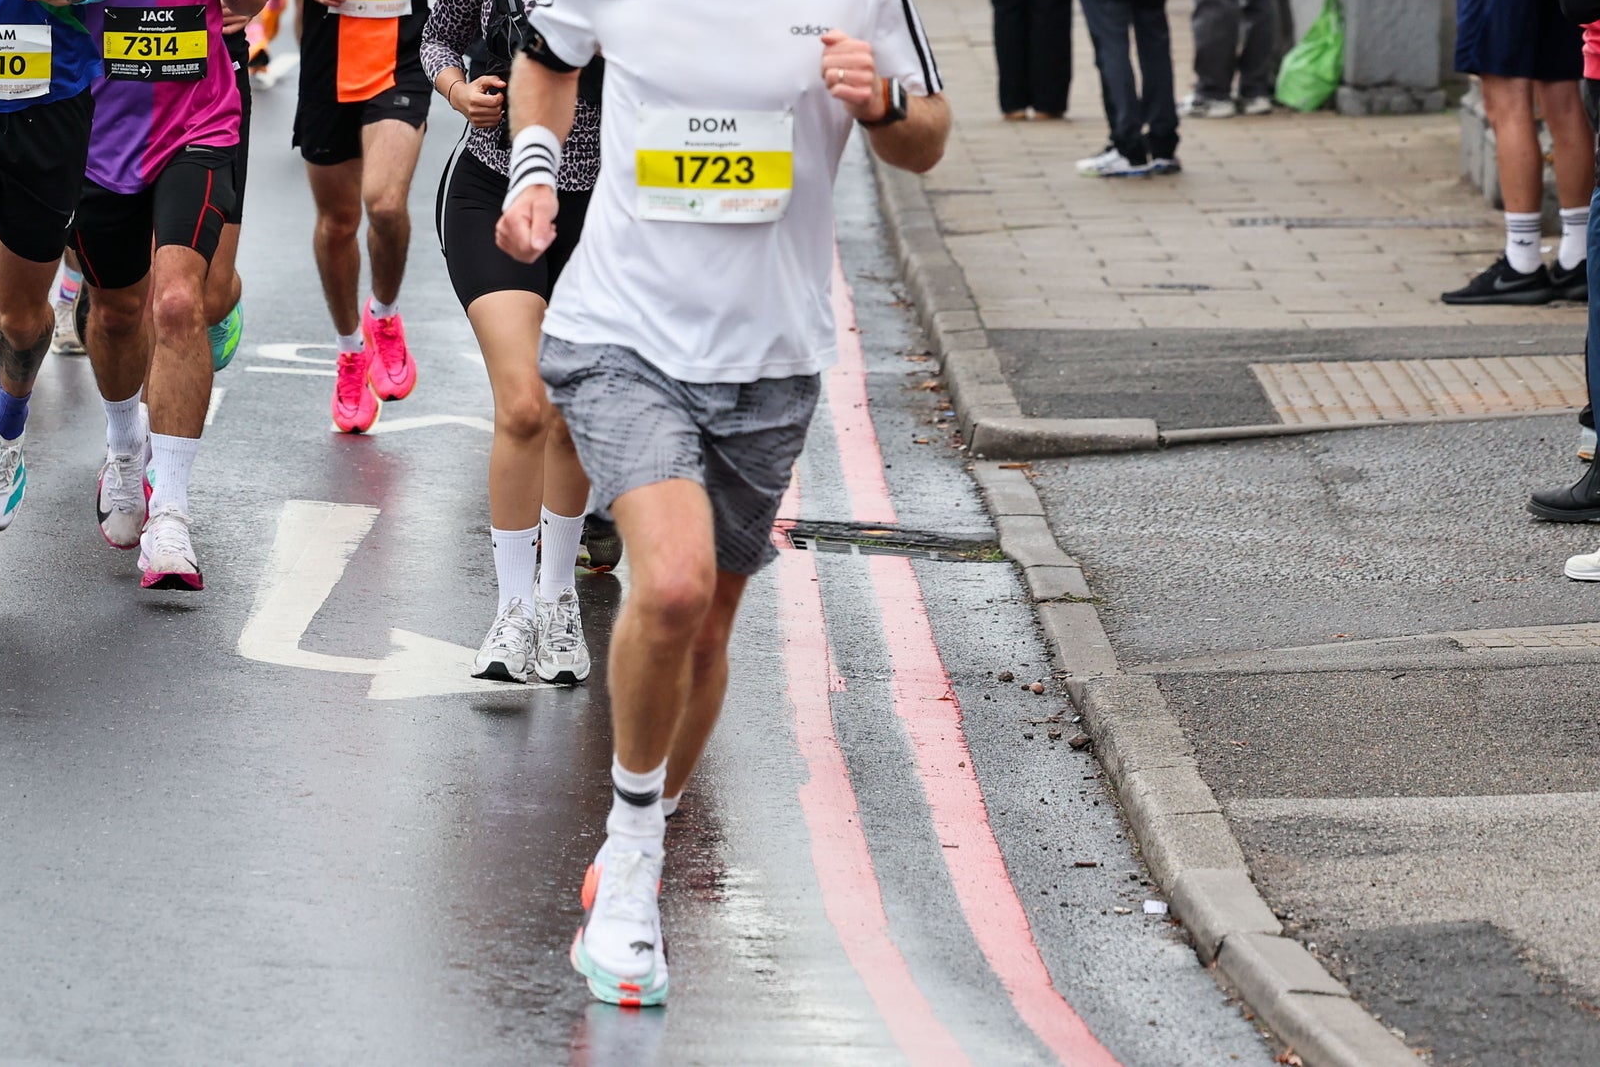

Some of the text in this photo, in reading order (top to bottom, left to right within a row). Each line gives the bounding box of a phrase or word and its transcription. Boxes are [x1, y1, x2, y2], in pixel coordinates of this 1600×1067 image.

[141, 10, 174, 22] JACK
[123, 36, 178, 56] 7314
[689, 118, 737, 132] DOM
[674, 156, 755, 184] 1723
